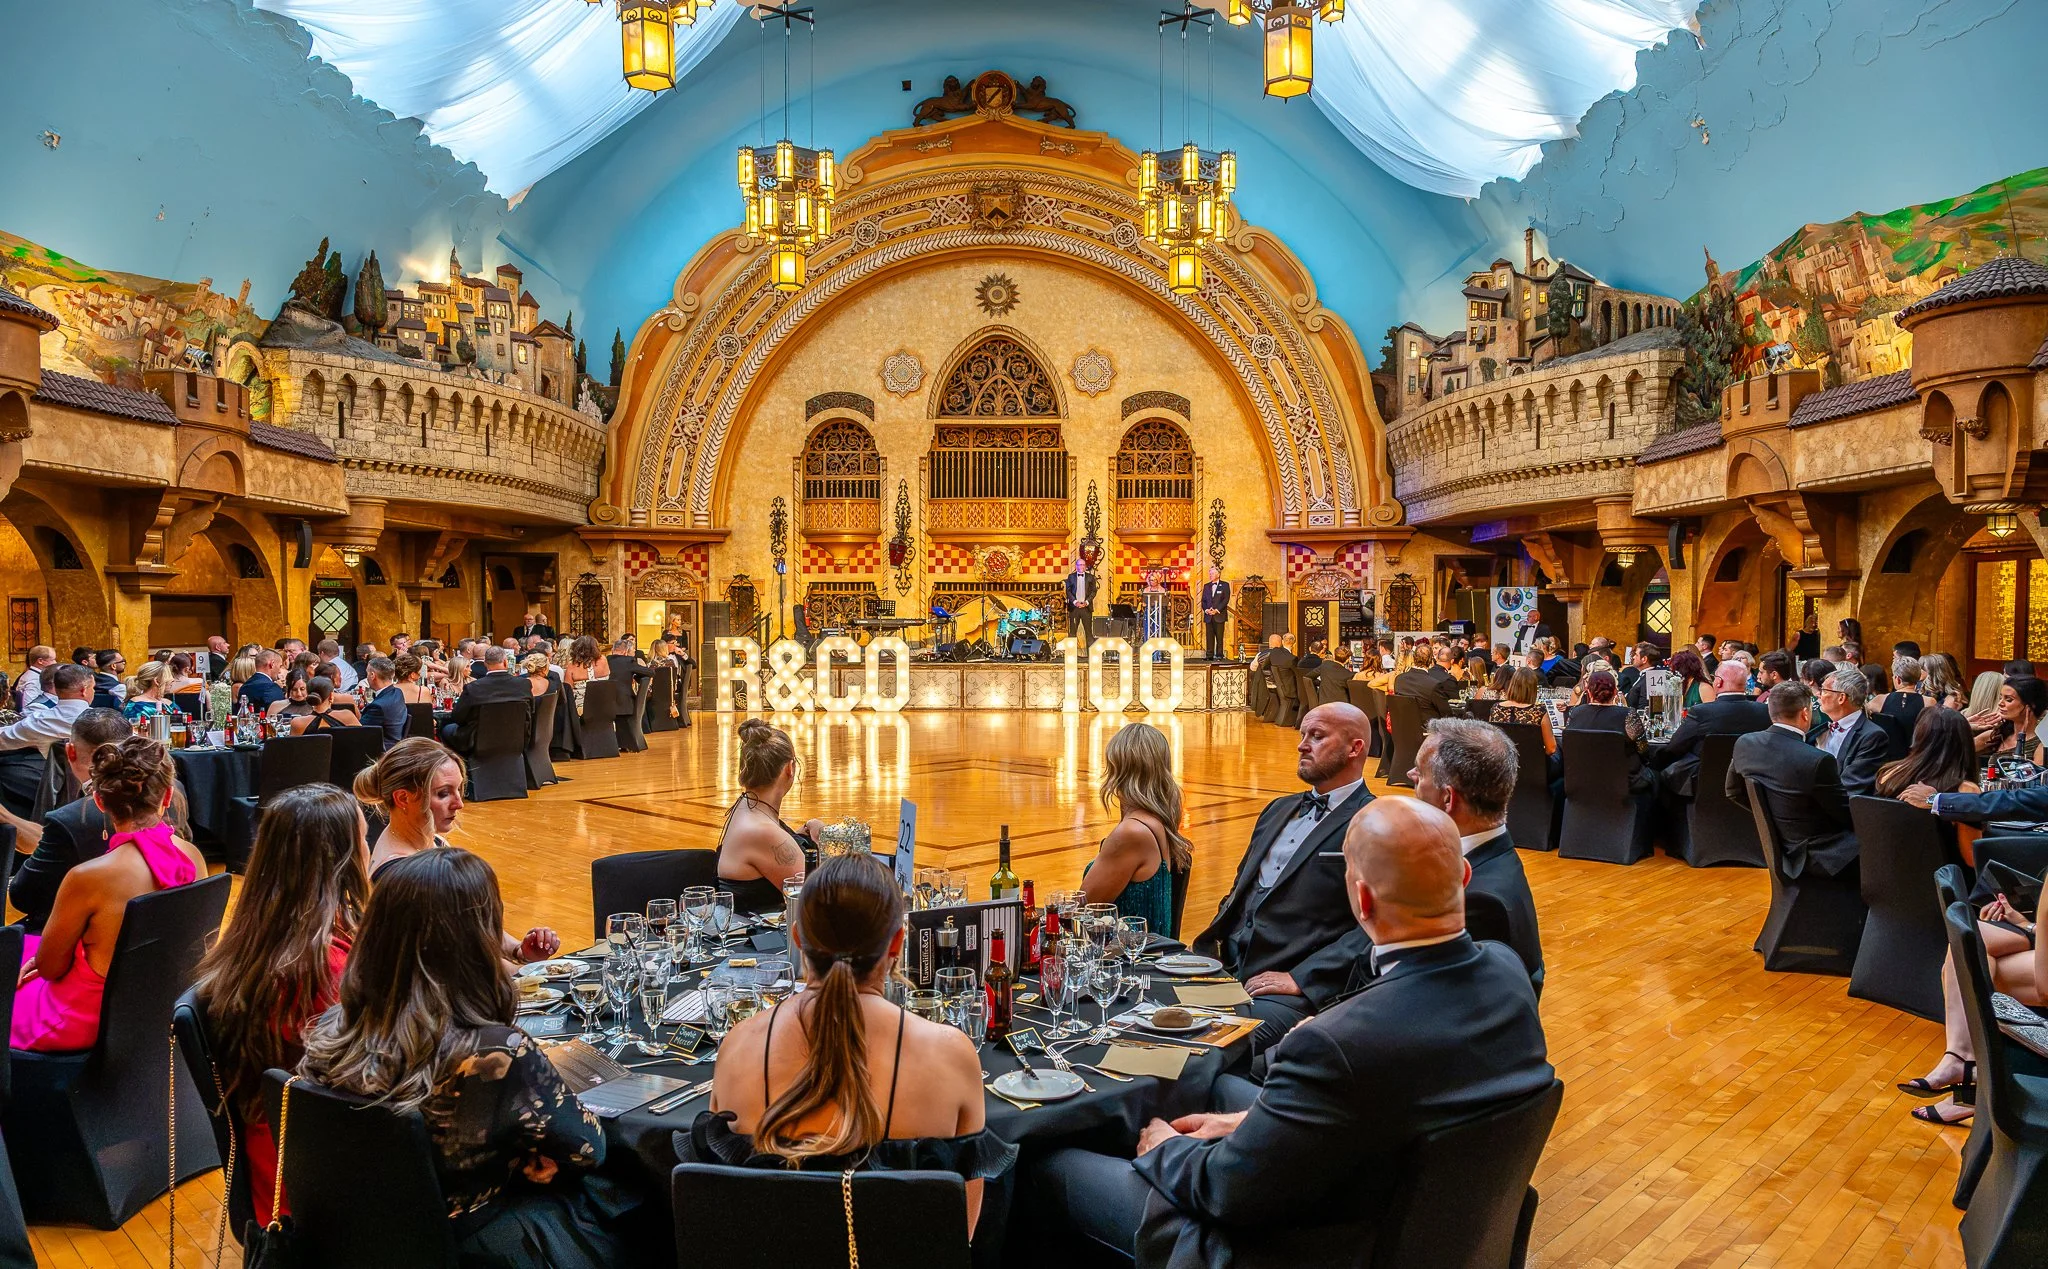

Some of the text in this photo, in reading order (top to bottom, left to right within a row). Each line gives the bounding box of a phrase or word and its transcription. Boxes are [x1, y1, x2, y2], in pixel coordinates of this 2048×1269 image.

[198, 655, 205, 664] 9
[715, 637, 1184, 712] R&CO 100
[1650, 676, 1664, 687] 14
[899, 819, 911, 854] 22
